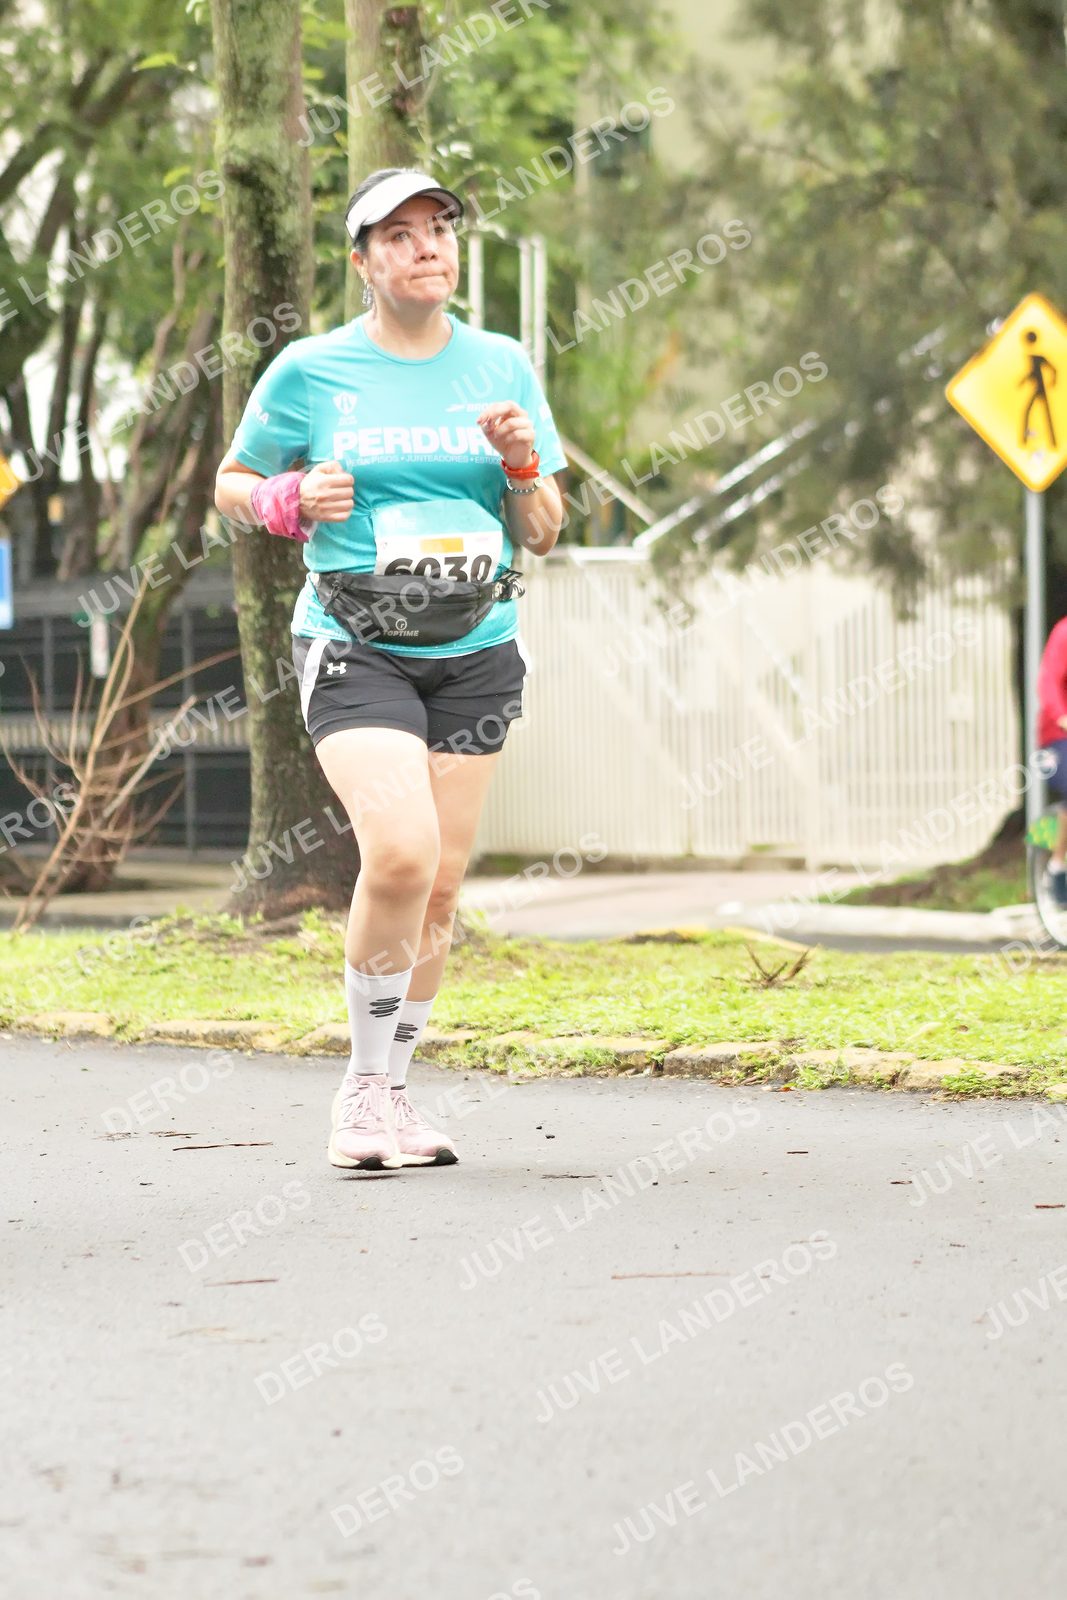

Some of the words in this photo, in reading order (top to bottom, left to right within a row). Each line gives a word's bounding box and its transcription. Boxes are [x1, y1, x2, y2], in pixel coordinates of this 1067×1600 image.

[333, 426, 501, 460] PERDUR
[405, 455, 468, 463] JUNTEADORES
[475, 456, 501, 464] ESTUC
